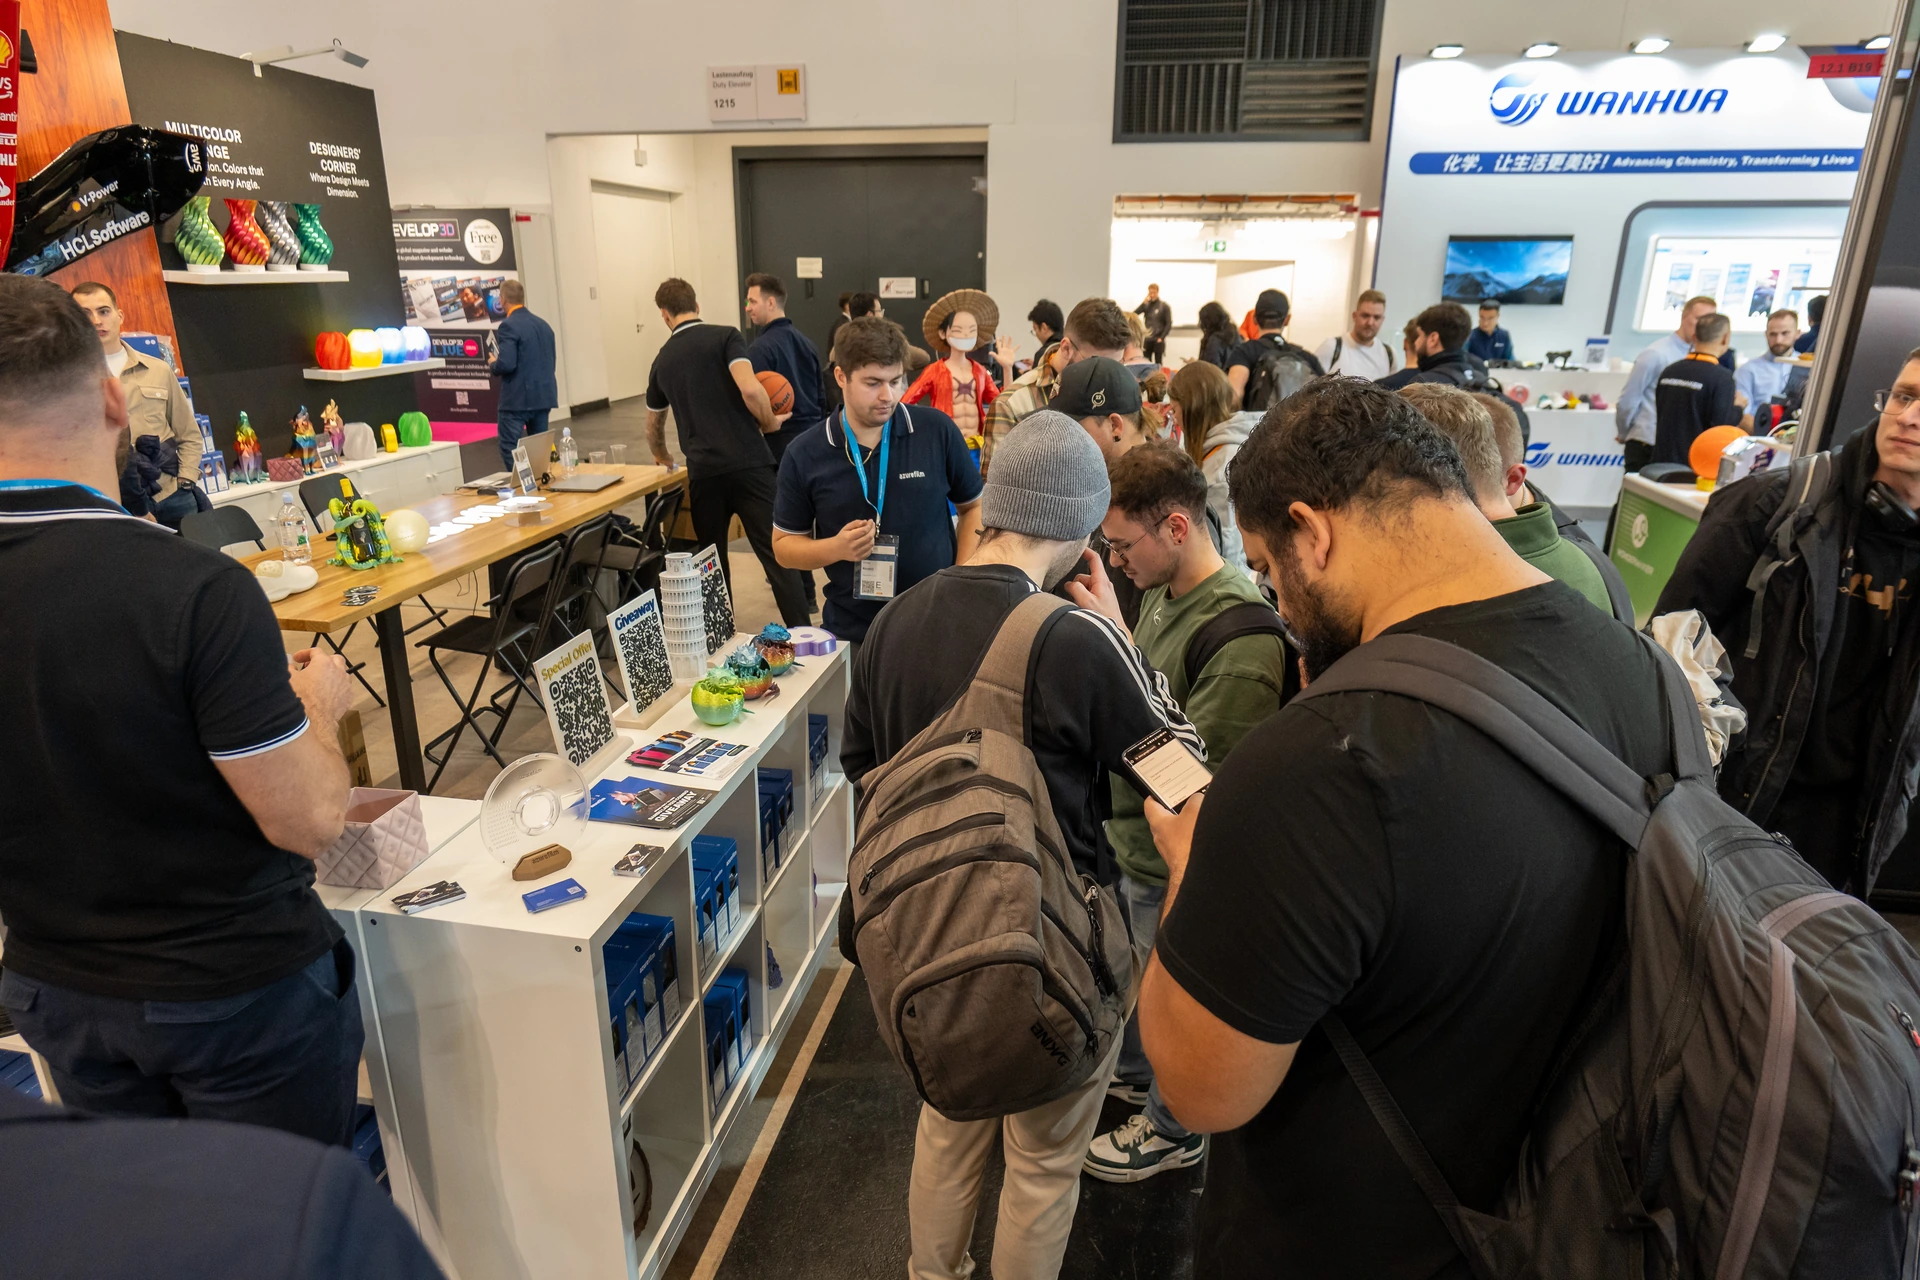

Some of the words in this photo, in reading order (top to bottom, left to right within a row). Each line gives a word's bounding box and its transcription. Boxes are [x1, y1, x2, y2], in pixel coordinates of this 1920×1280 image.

[712, 71, 754, 79] Lastenaufzug
[1819, 63, 1844, 73] 12.1
[712, 81, 726, 89] Duty
[728, 80, 752, 88] Elevator
[714, 98, 736, 108] 1215
[1555, 88, 1729, 115] WANHUA
[165, 121, 242, 143] MULTICOLOR
[189, 143, 202, 172] aws
[309, 141, 361, 160] DESIGNERS'
[320, 159, 357, 175] CORNER
[1612, 156, 1673, 168] Advancing
[1675, 155, 1738, 168] Chemistry,
[1741, 154, 1818, 168] Transforming
[1821, 154, 1855, 166] Lives
[223, 163, 247, 176] Colors
[249, 165, 264, 176] that
[212, 177, 235, 190] Every
[236, 179, 260, 191] Angle.
[309, 172, 331, 184] Where
[331, 174, 352, 187] Design
[352, 176, 370, 187] Meets
[79, 180, 119, 207] V-Power
[326, 186, 359, 198] Dimension.
[60, 211, 150, 260] HCLSoftware
[469, 231, 498, 243] Free
[433, 345, 465, 356] LIVE
[899, 470, 926, 480] azurefilm
[614, 598, 656, 632] Giveaway
[540, 655, 572, 682] Special
[572, 641, 593, 664] Offer
[654, 791, 698, 822] GIVEAWAY
[532, 849, 560, 864] azurefilm
